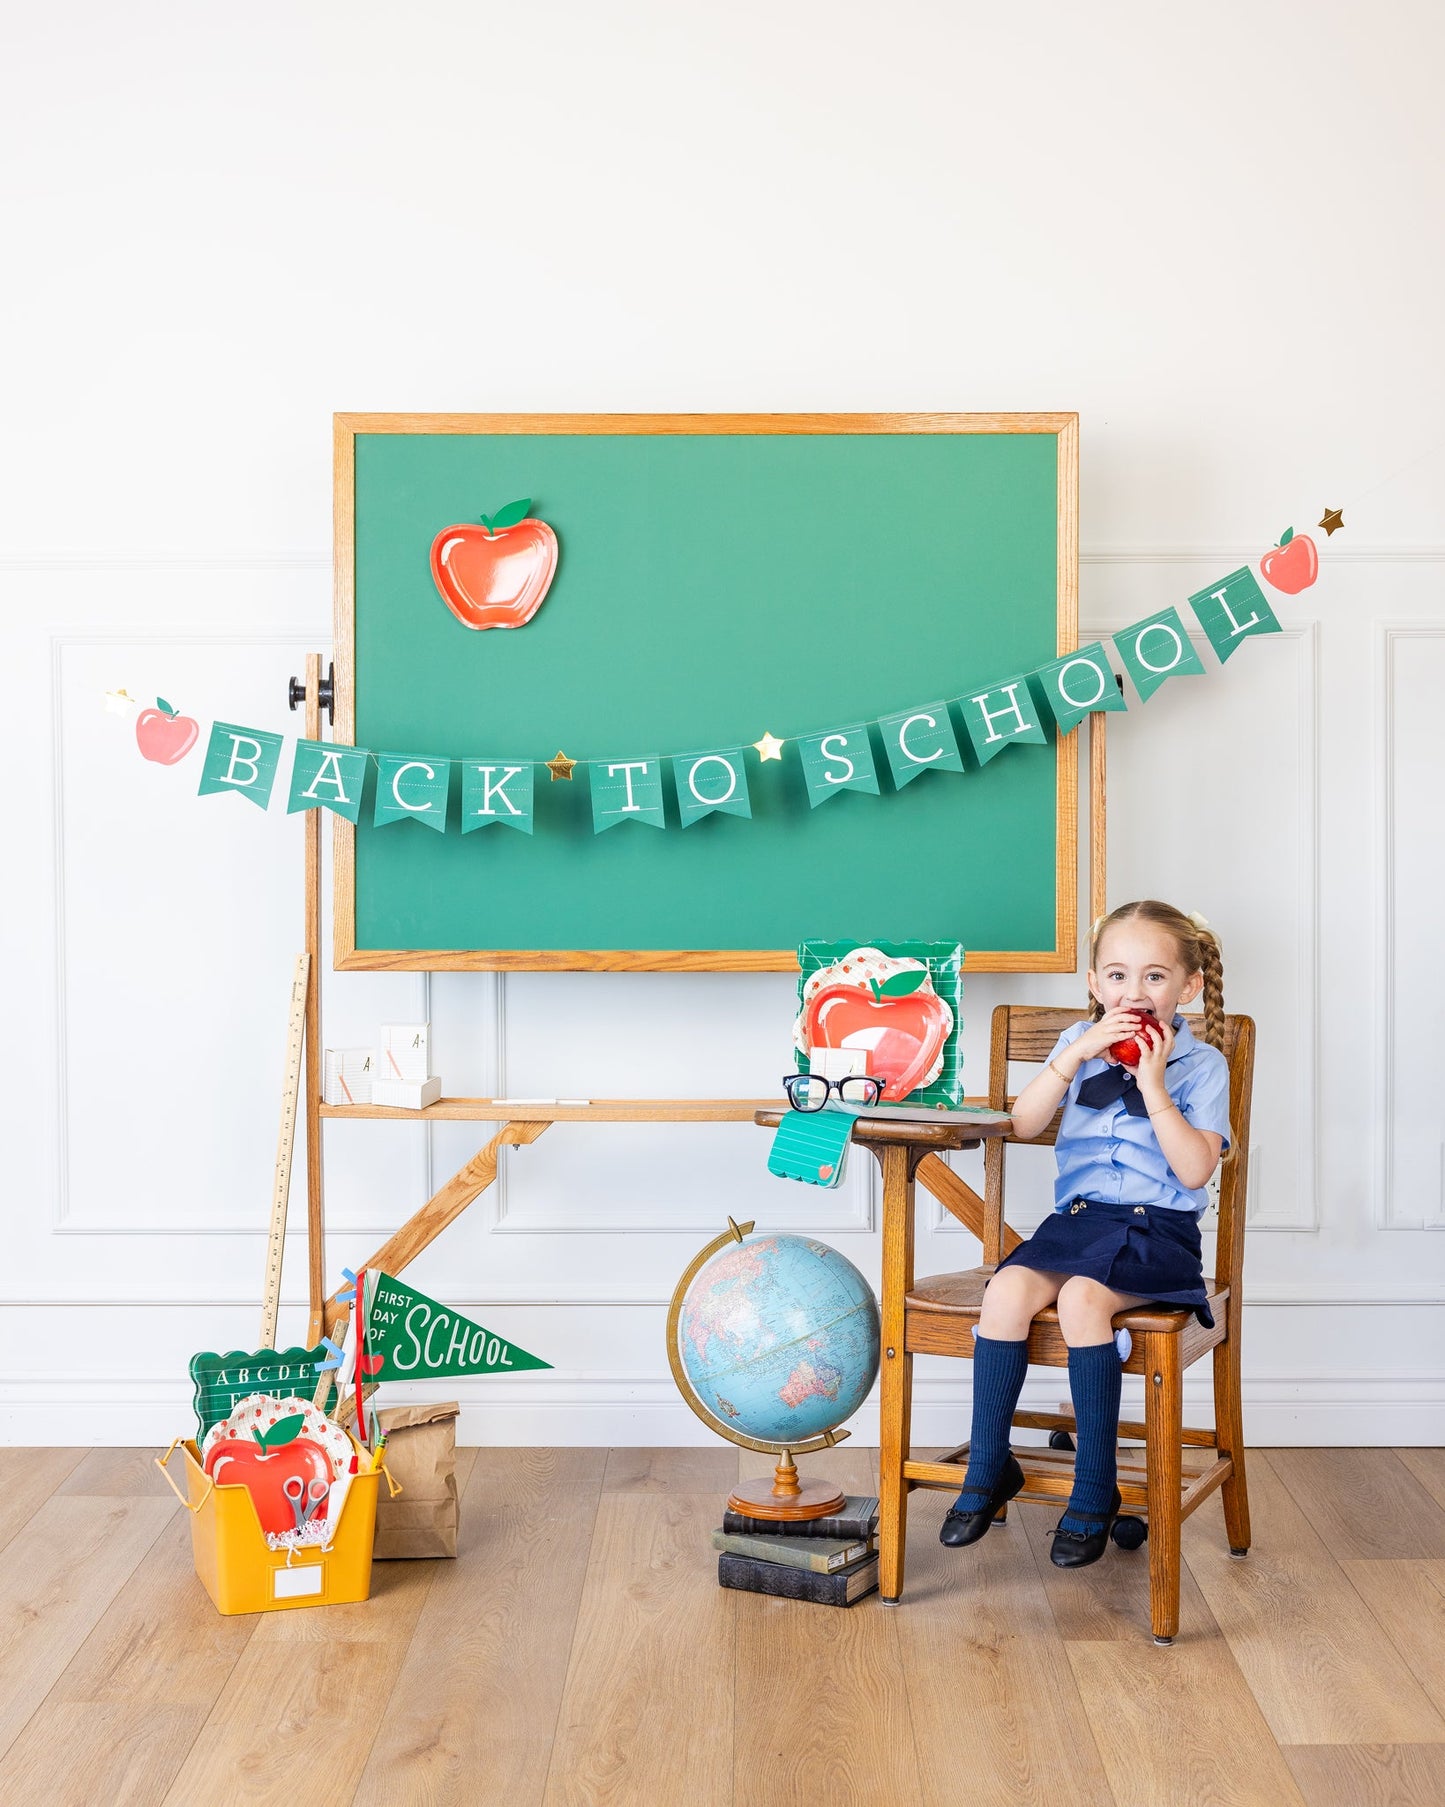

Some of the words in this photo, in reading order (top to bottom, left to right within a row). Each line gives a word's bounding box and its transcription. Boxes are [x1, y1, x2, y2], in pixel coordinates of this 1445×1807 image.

[220, 733, 522, 816] BACK
[608, 755, 736, 812] TO
[820, 587, 1259, 784] SCHOOL
[377, 1290, 413, 1308] FIRST
[372, 1309, 399, 1324] DAY
[369, 1328, 386, 1341] OF
[393, 1303, 513, 1370] SCHOOL
